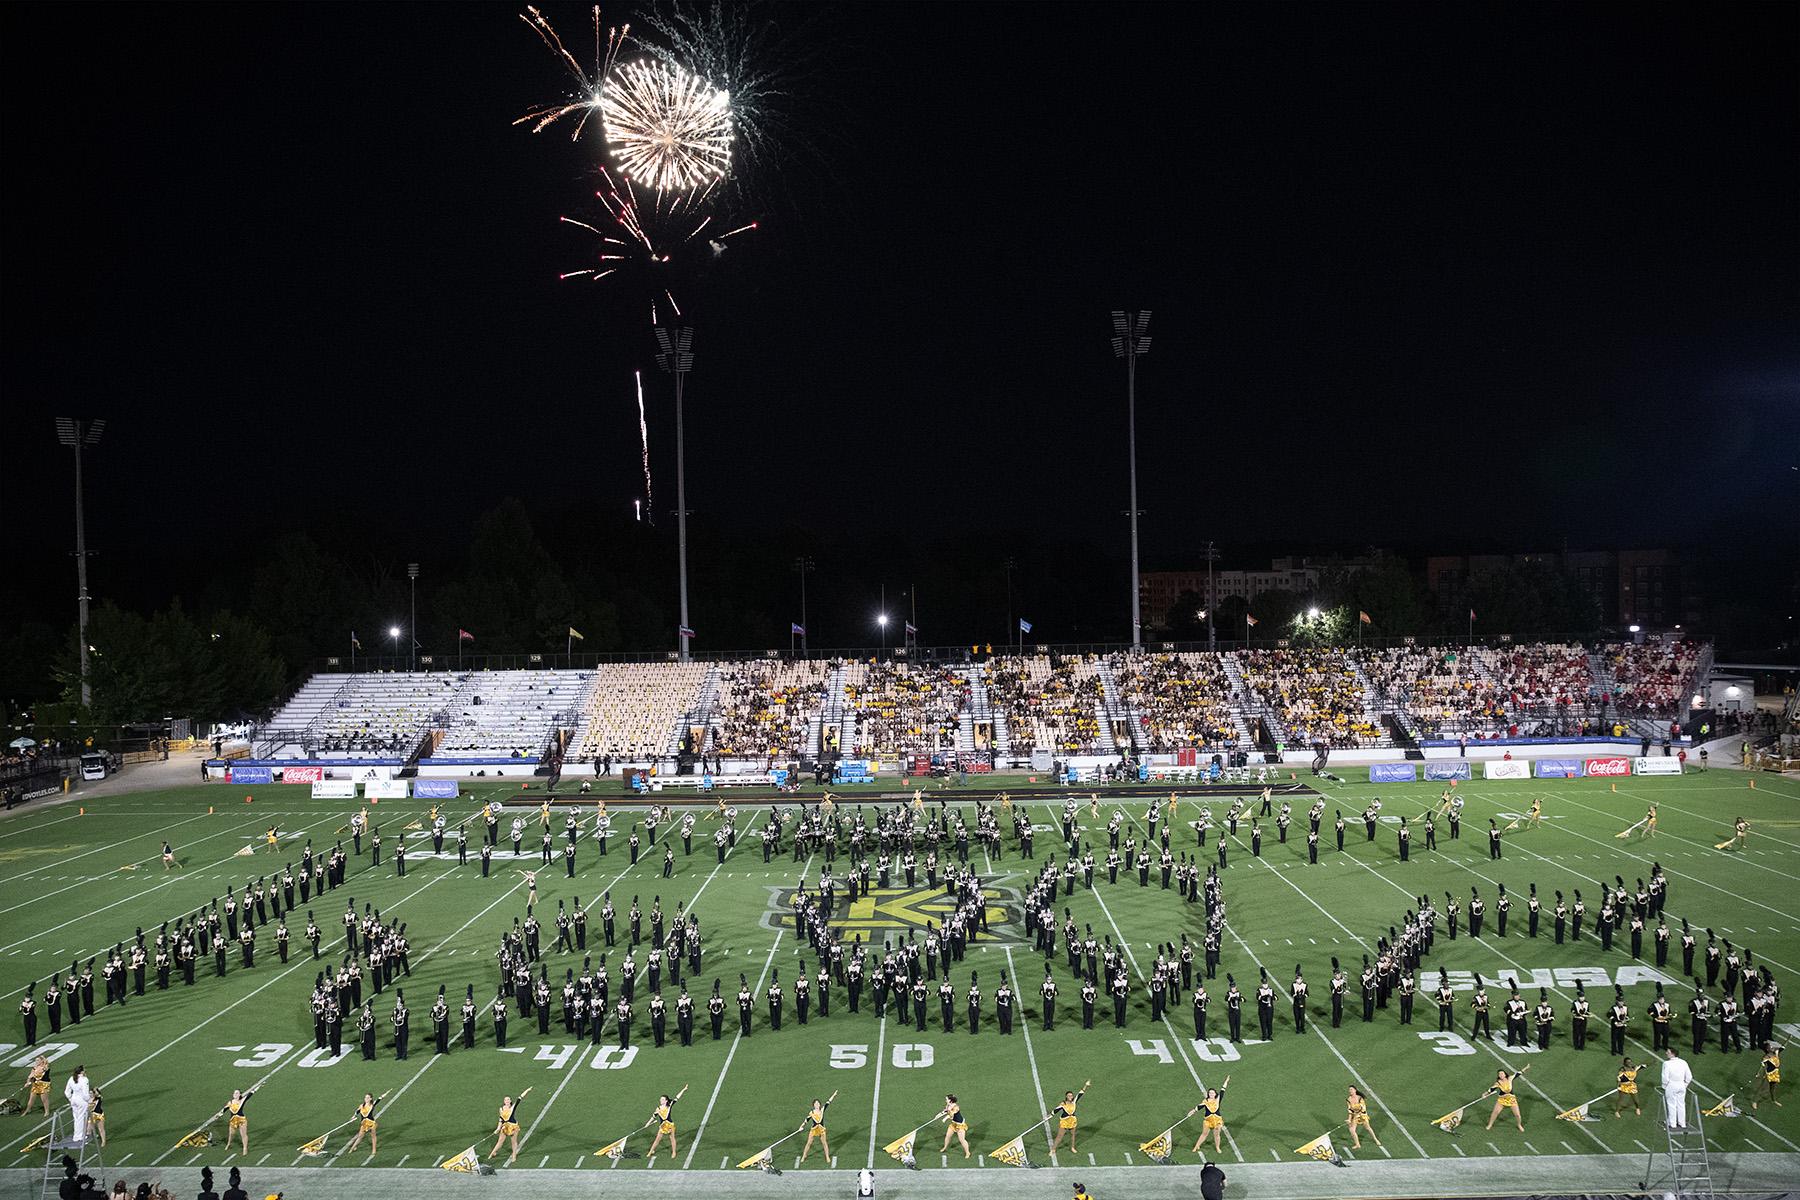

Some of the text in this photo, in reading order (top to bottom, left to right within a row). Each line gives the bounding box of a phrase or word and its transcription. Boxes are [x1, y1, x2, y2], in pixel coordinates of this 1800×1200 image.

[233, 1043, 355, 1068] 30
[532, 1043, 640, 1070] 40
[829, 1043, 934, 1069] 50
[1125, 1037, 1242, 1065] 40
